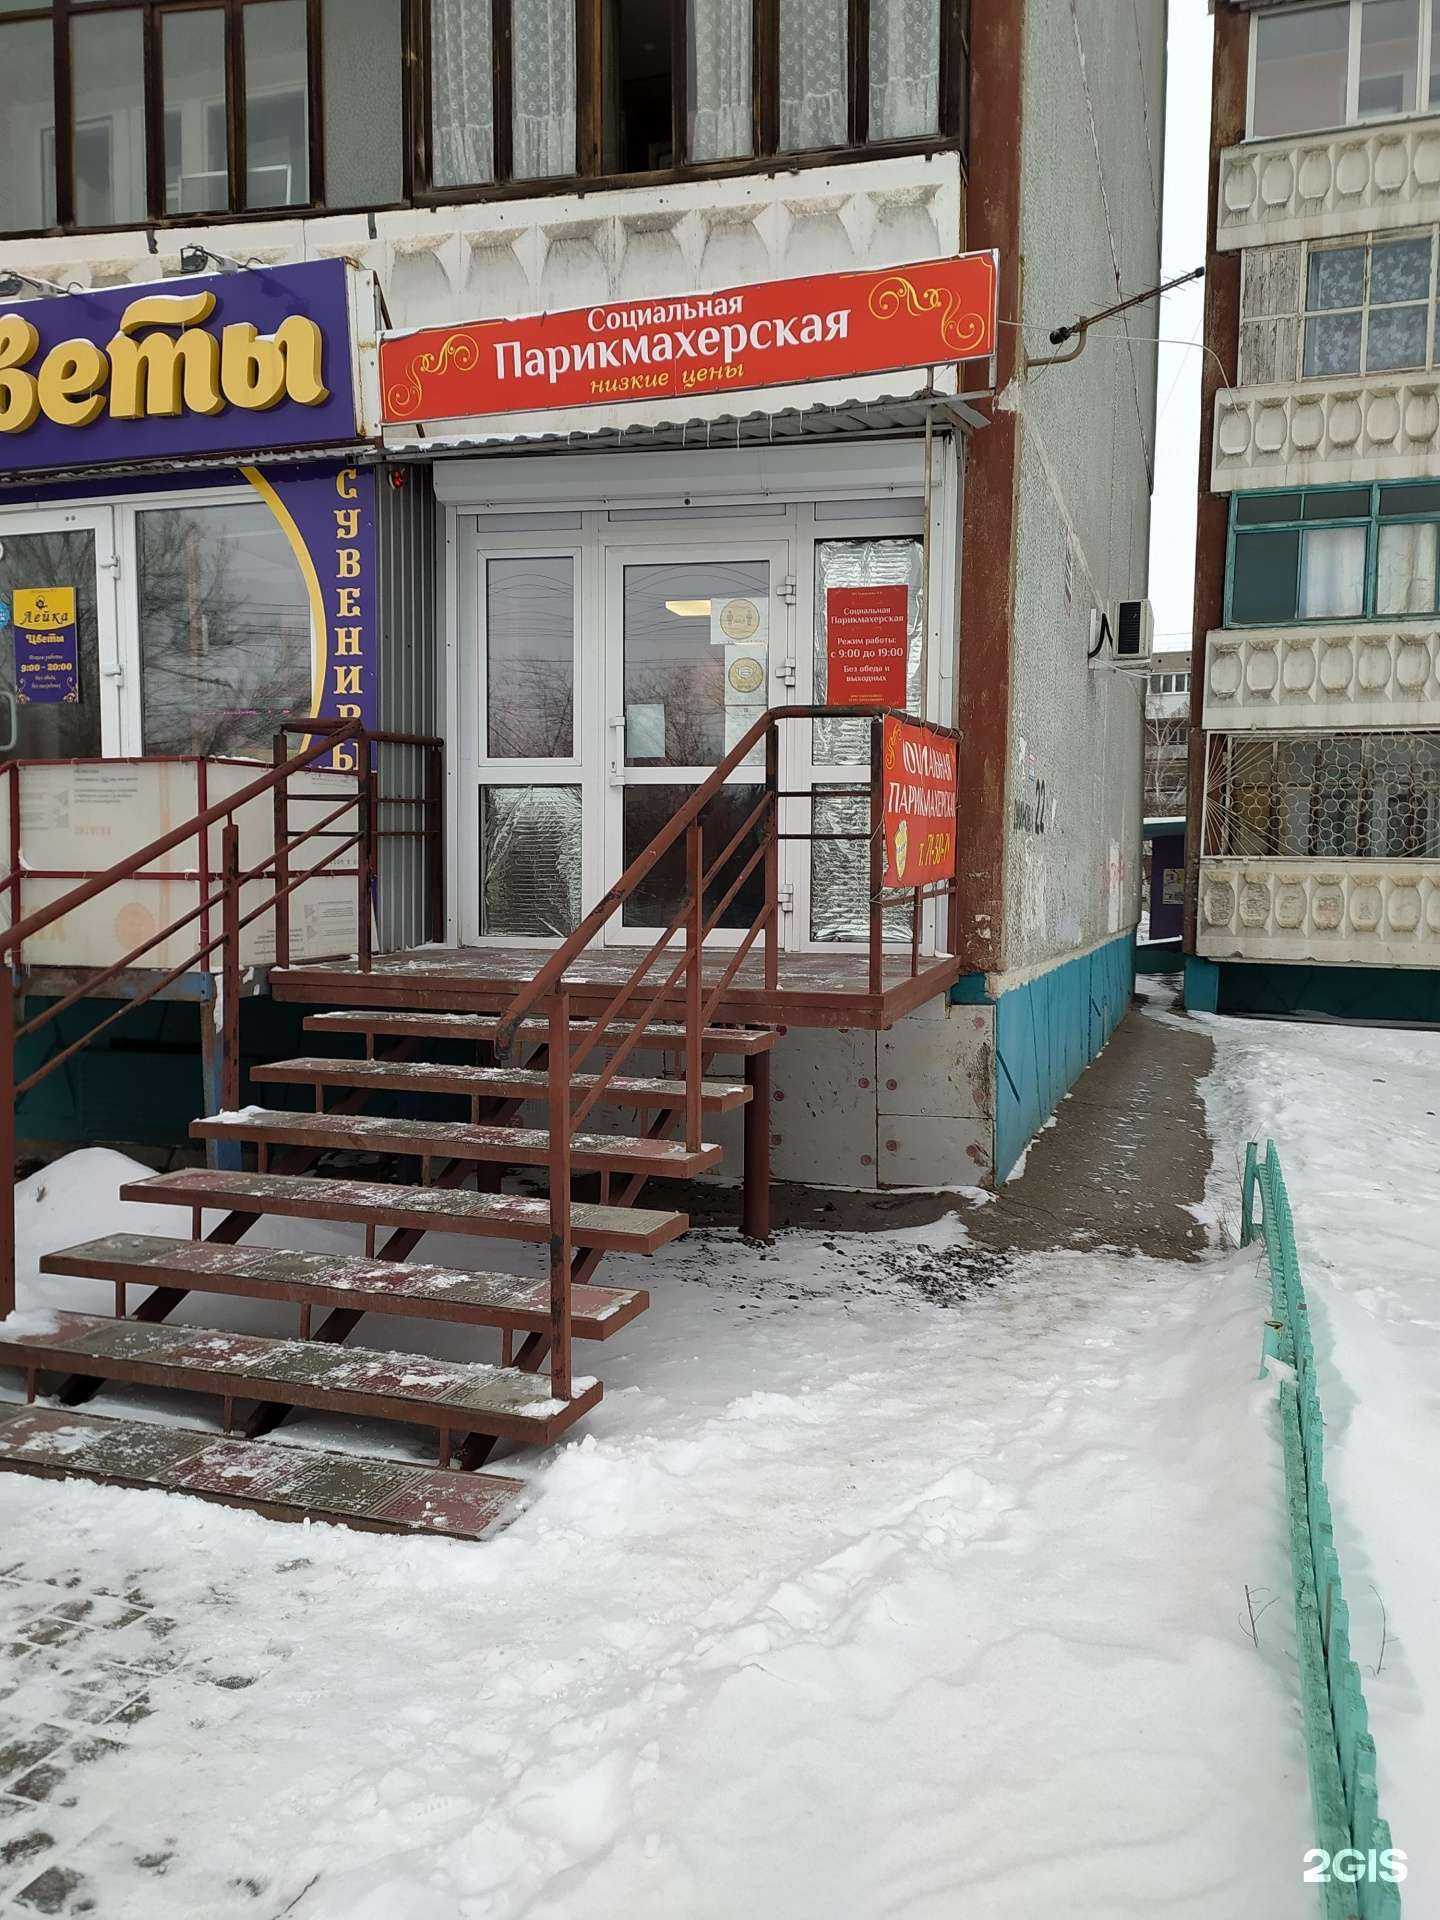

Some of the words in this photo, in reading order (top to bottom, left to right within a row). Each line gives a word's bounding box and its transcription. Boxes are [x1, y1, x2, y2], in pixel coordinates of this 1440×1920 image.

[588, 295, 744, 333] Социальная
[494, 308, 852, 384] Парикмахерская
[590, 371, 670, 394] низкие
[682, 364, 744, 389] цены
[20, 610, 68, 625] Лейка
[843, 607, 891, 616] Социальная
[831, 615, 904, 625] Парикмахерская
[837, 637, 864, 645] Режим
[865, 636, 897, 646] работы:
[838, 648, 860, 658] 9:00
[862, 651, 876, 659] до
[878, 647, 904, 657] 19:00
[843, 665, 858, 673] Без
[859, 664, 883, 673] обеда
